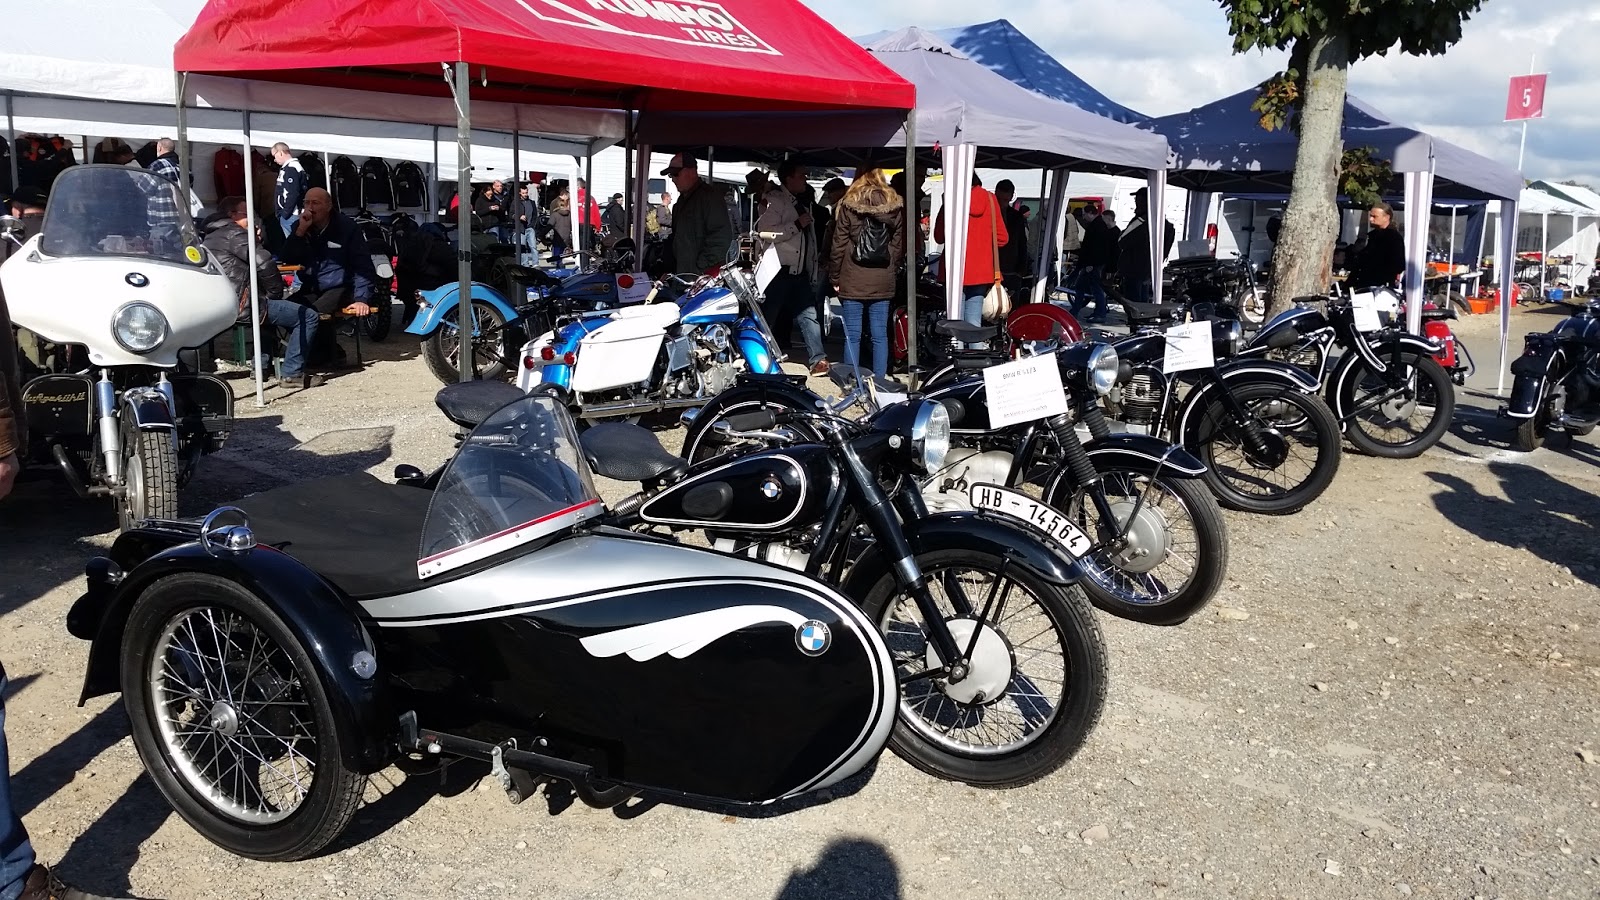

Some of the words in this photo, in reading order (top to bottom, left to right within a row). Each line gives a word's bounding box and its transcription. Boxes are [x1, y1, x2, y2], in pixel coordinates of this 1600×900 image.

[680, 27, 757, 47] TIRES
[1522, 88, 1532, 108] 5
[981, 488, 1003, 508] HB
[1029, 504, 1083, 549] 14564
